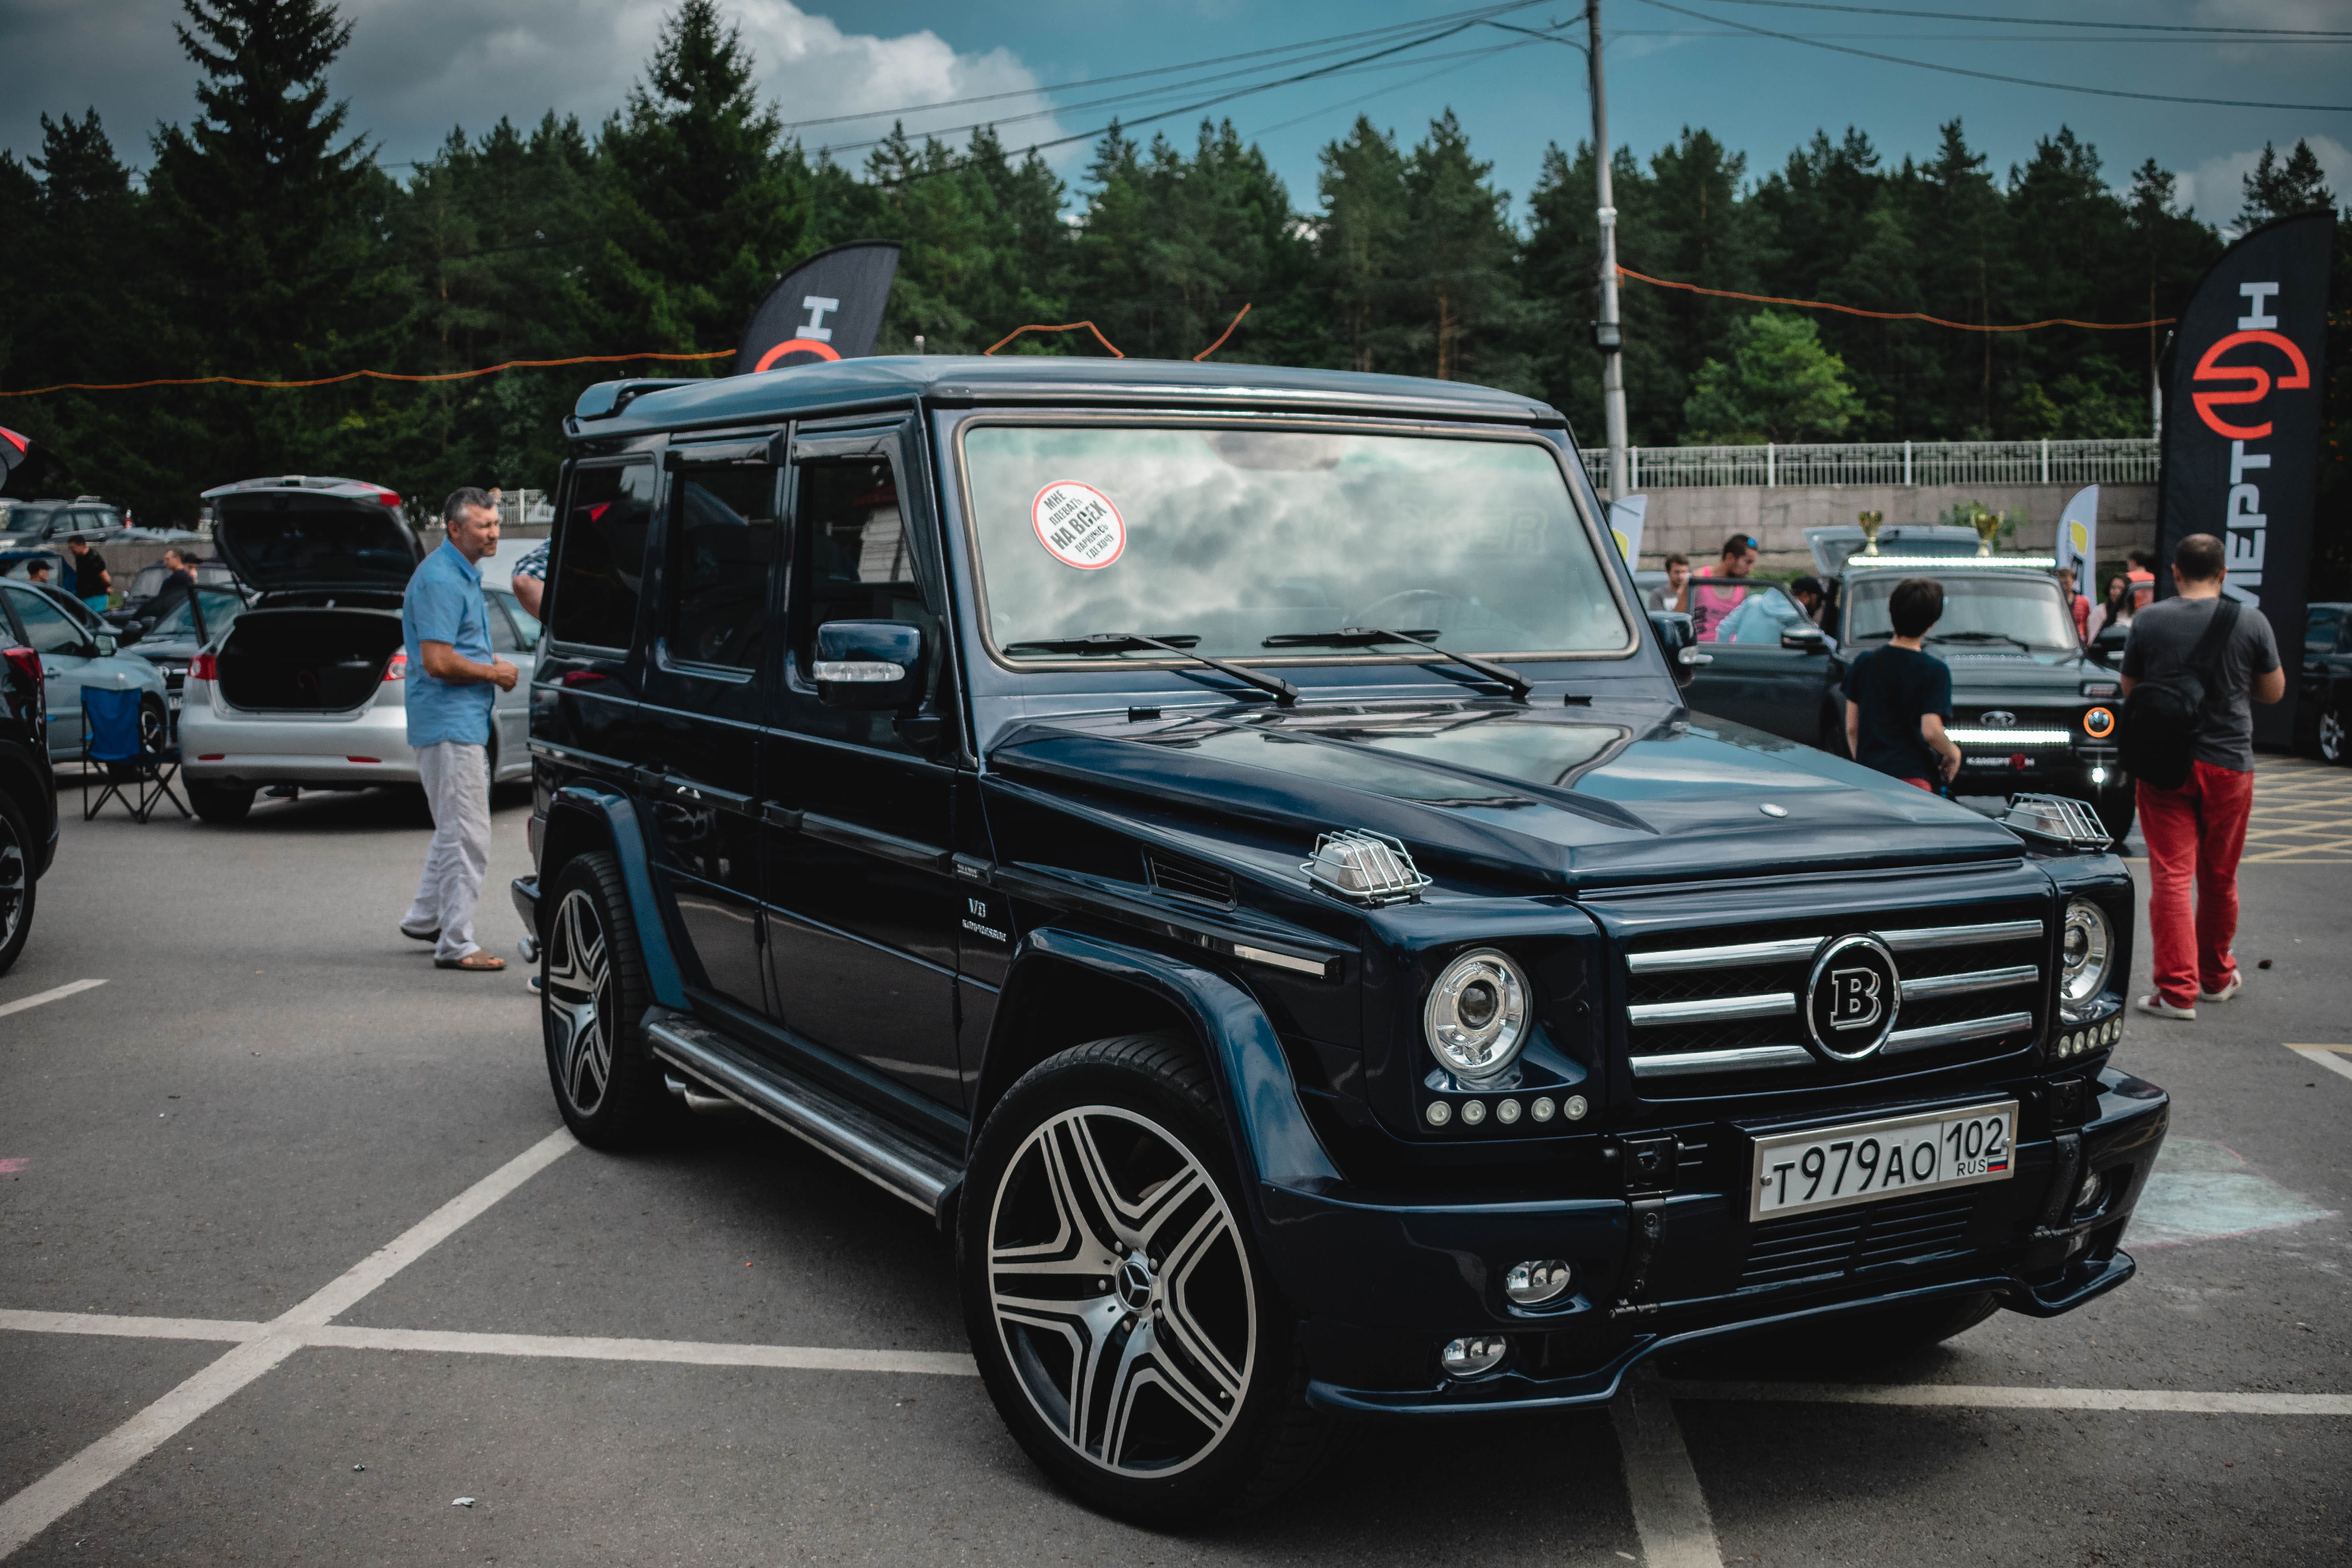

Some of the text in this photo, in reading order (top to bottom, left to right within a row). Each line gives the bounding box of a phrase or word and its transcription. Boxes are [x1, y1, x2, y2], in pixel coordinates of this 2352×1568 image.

[2192, 282, 2310, 609] МЕРТОН
[1043, 489, 1067, 511] МНЕ
[1049, 497, 1083, 526] ПЛЕВАТЬ
[1050, 500, 1107, 550] НА ВСЕХ
[1074, 523, 1109, 553] ПАРКУЮСЬ
[1085, 532, 1115, 559] ГДЕ ХОЧУ
[968, 898, 986, 918] V8
[1946, 1116, 2003, 1161] 102
[1956, 1159, 1986, 1176] RUS
